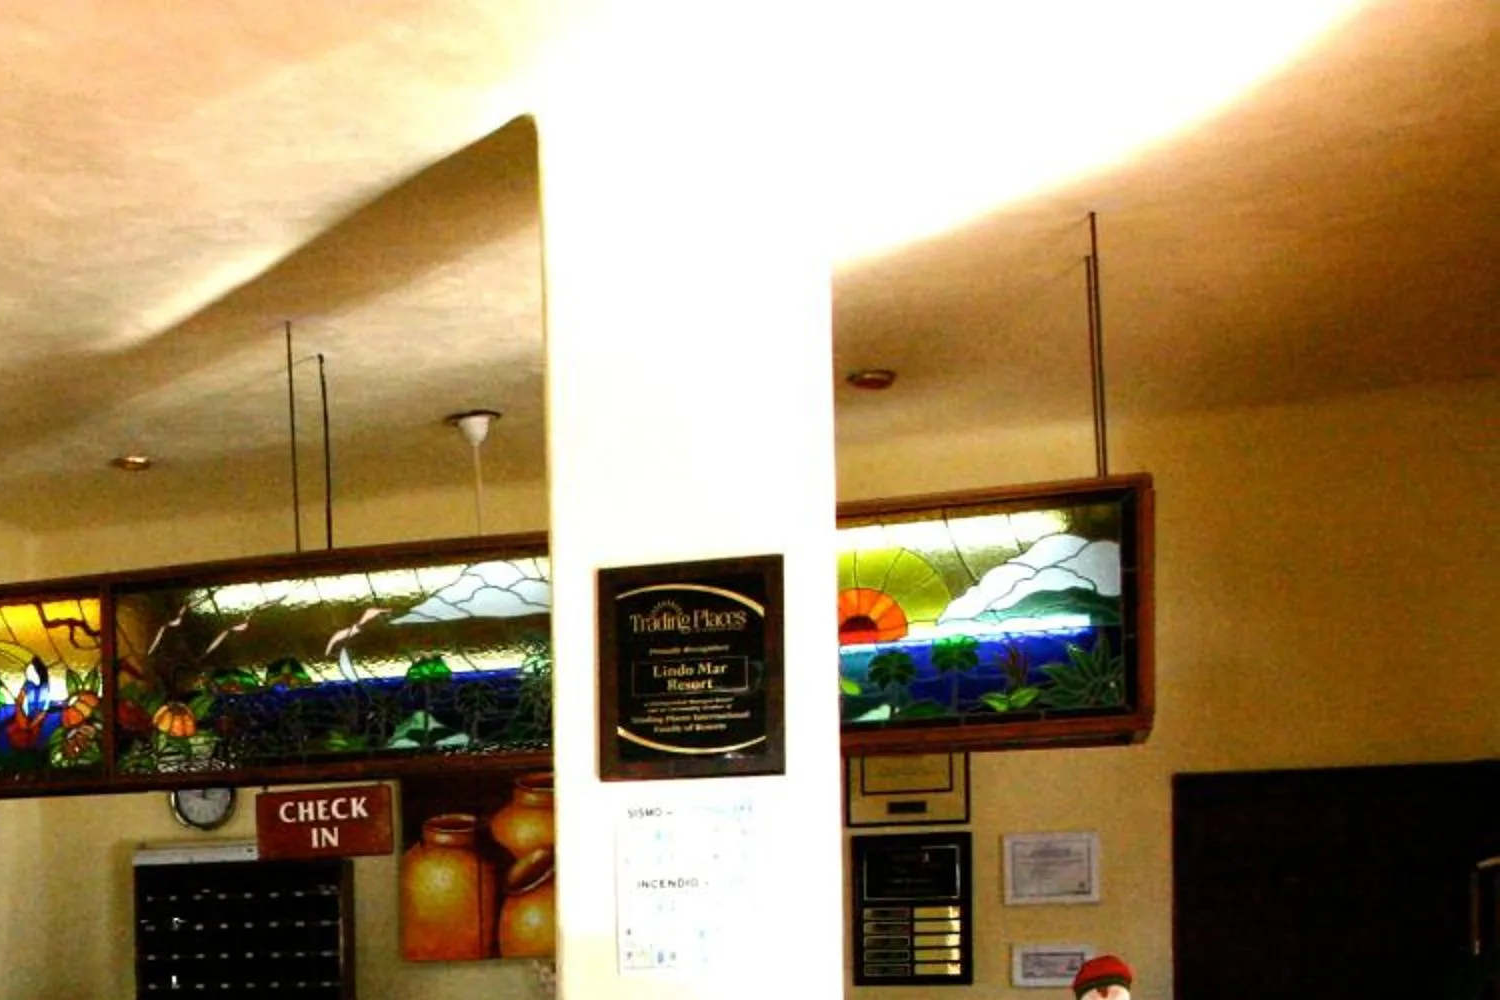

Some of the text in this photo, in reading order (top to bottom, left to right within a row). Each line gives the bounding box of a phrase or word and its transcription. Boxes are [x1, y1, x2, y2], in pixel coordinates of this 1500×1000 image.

[629, 608, 747, 634] Trading Places
[652, 661, 728, 679] Lindo Mar
[667, 679, 714, 691] Resort
[279, 797, 370, 823] CHECK
[311, 827, 340, 849] IN
